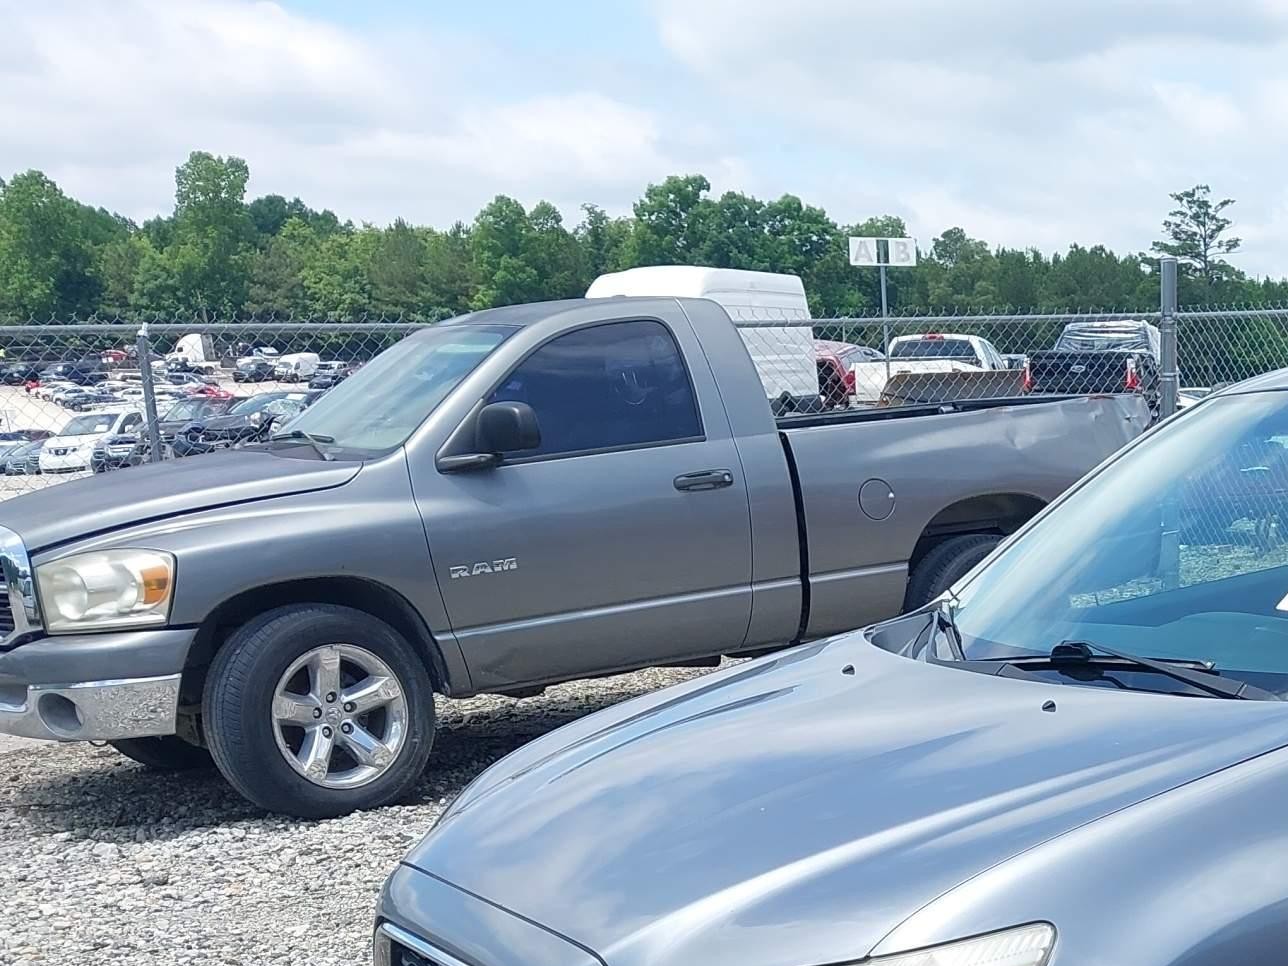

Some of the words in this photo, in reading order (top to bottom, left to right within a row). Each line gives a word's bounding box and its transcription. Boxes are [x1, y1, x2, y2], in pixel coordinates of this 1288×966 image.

[854, 240, 874, 262] A
[895, 241, 911, 263] B
[449, 557, 518, 579] RAM
